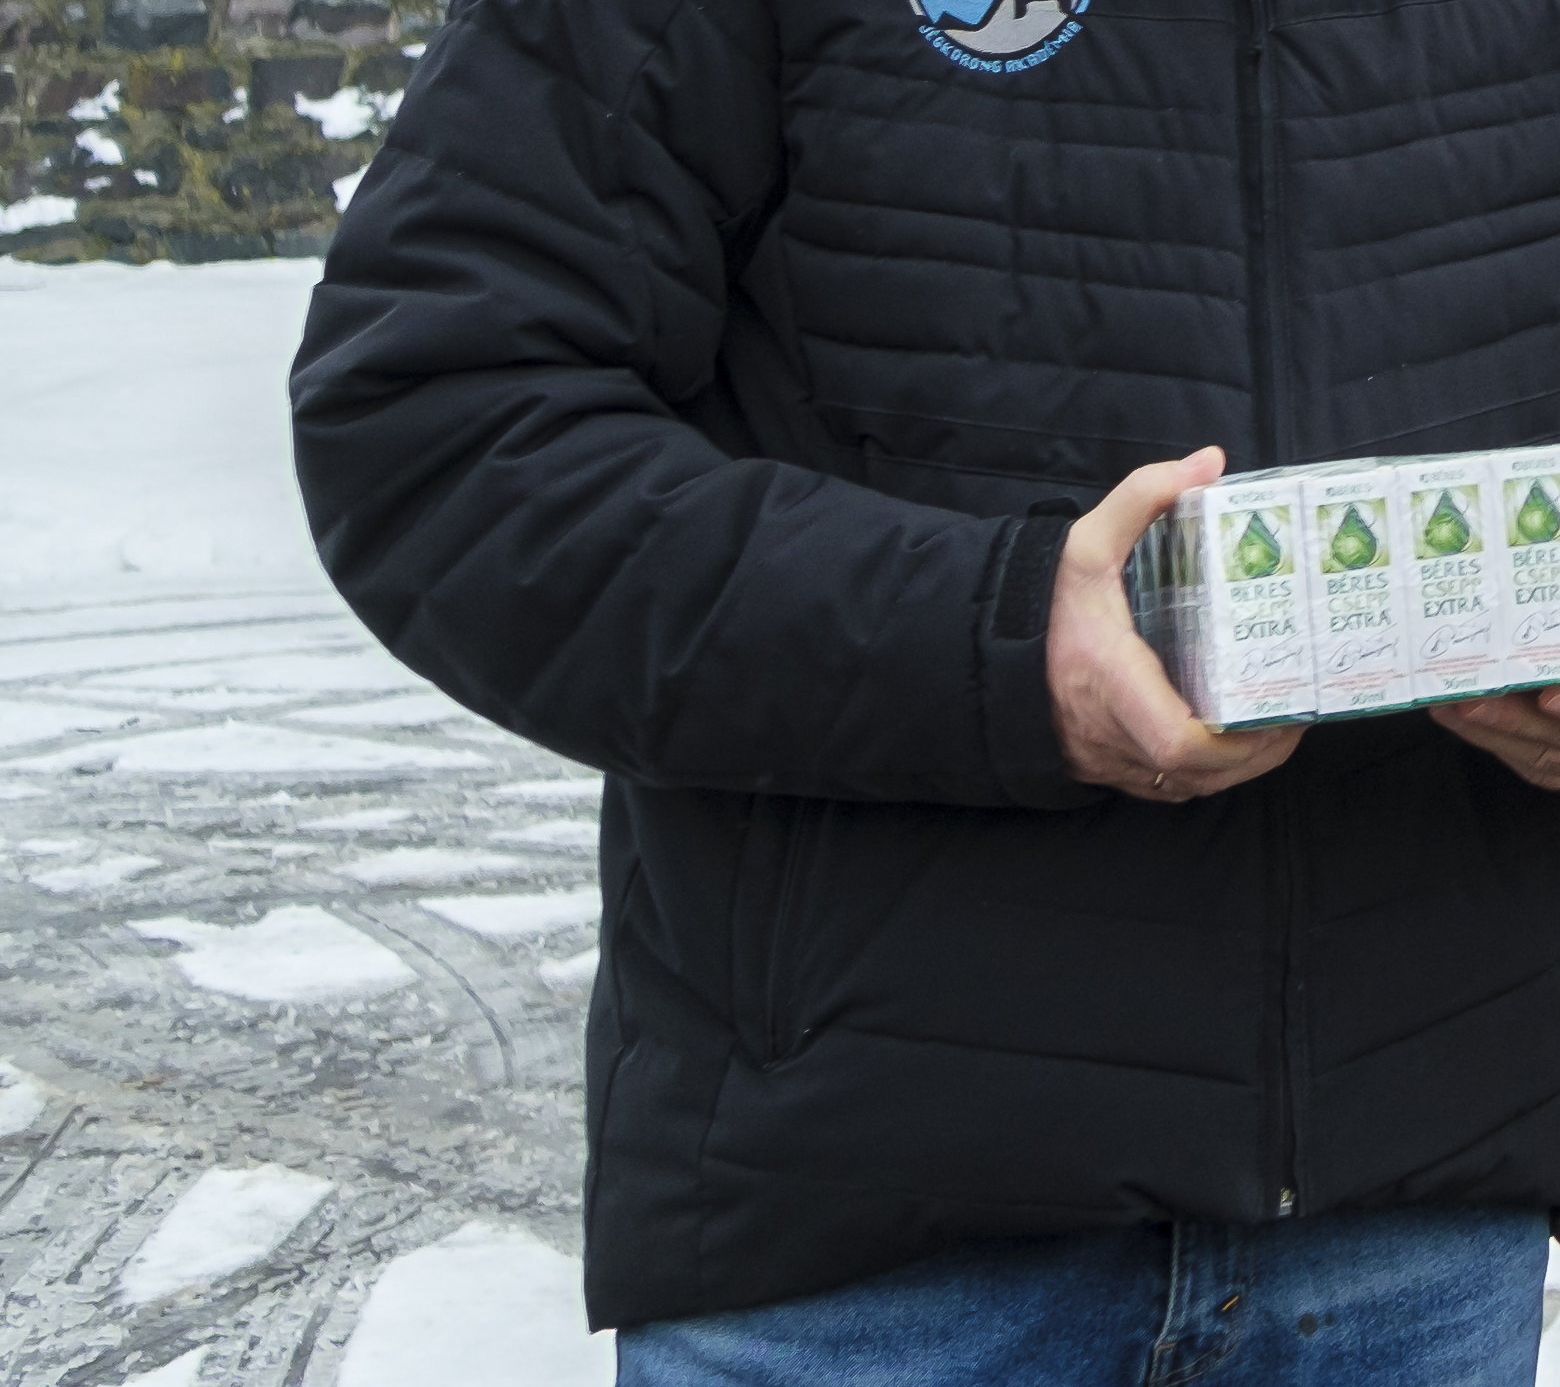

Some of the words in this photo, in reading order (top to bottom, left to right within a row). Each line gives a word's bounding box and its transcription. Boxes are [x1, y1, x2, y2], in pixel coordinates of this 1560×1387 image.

[1421, 559, 1482, 580] BÉRES
[1327, 572, 1389, 595] BÉRES
[1421, 578, 1482, 599] CSEPP
[1423, 596, 1484, 619] EXTRA
[1329, 610, 1392, 633] EXTRA
